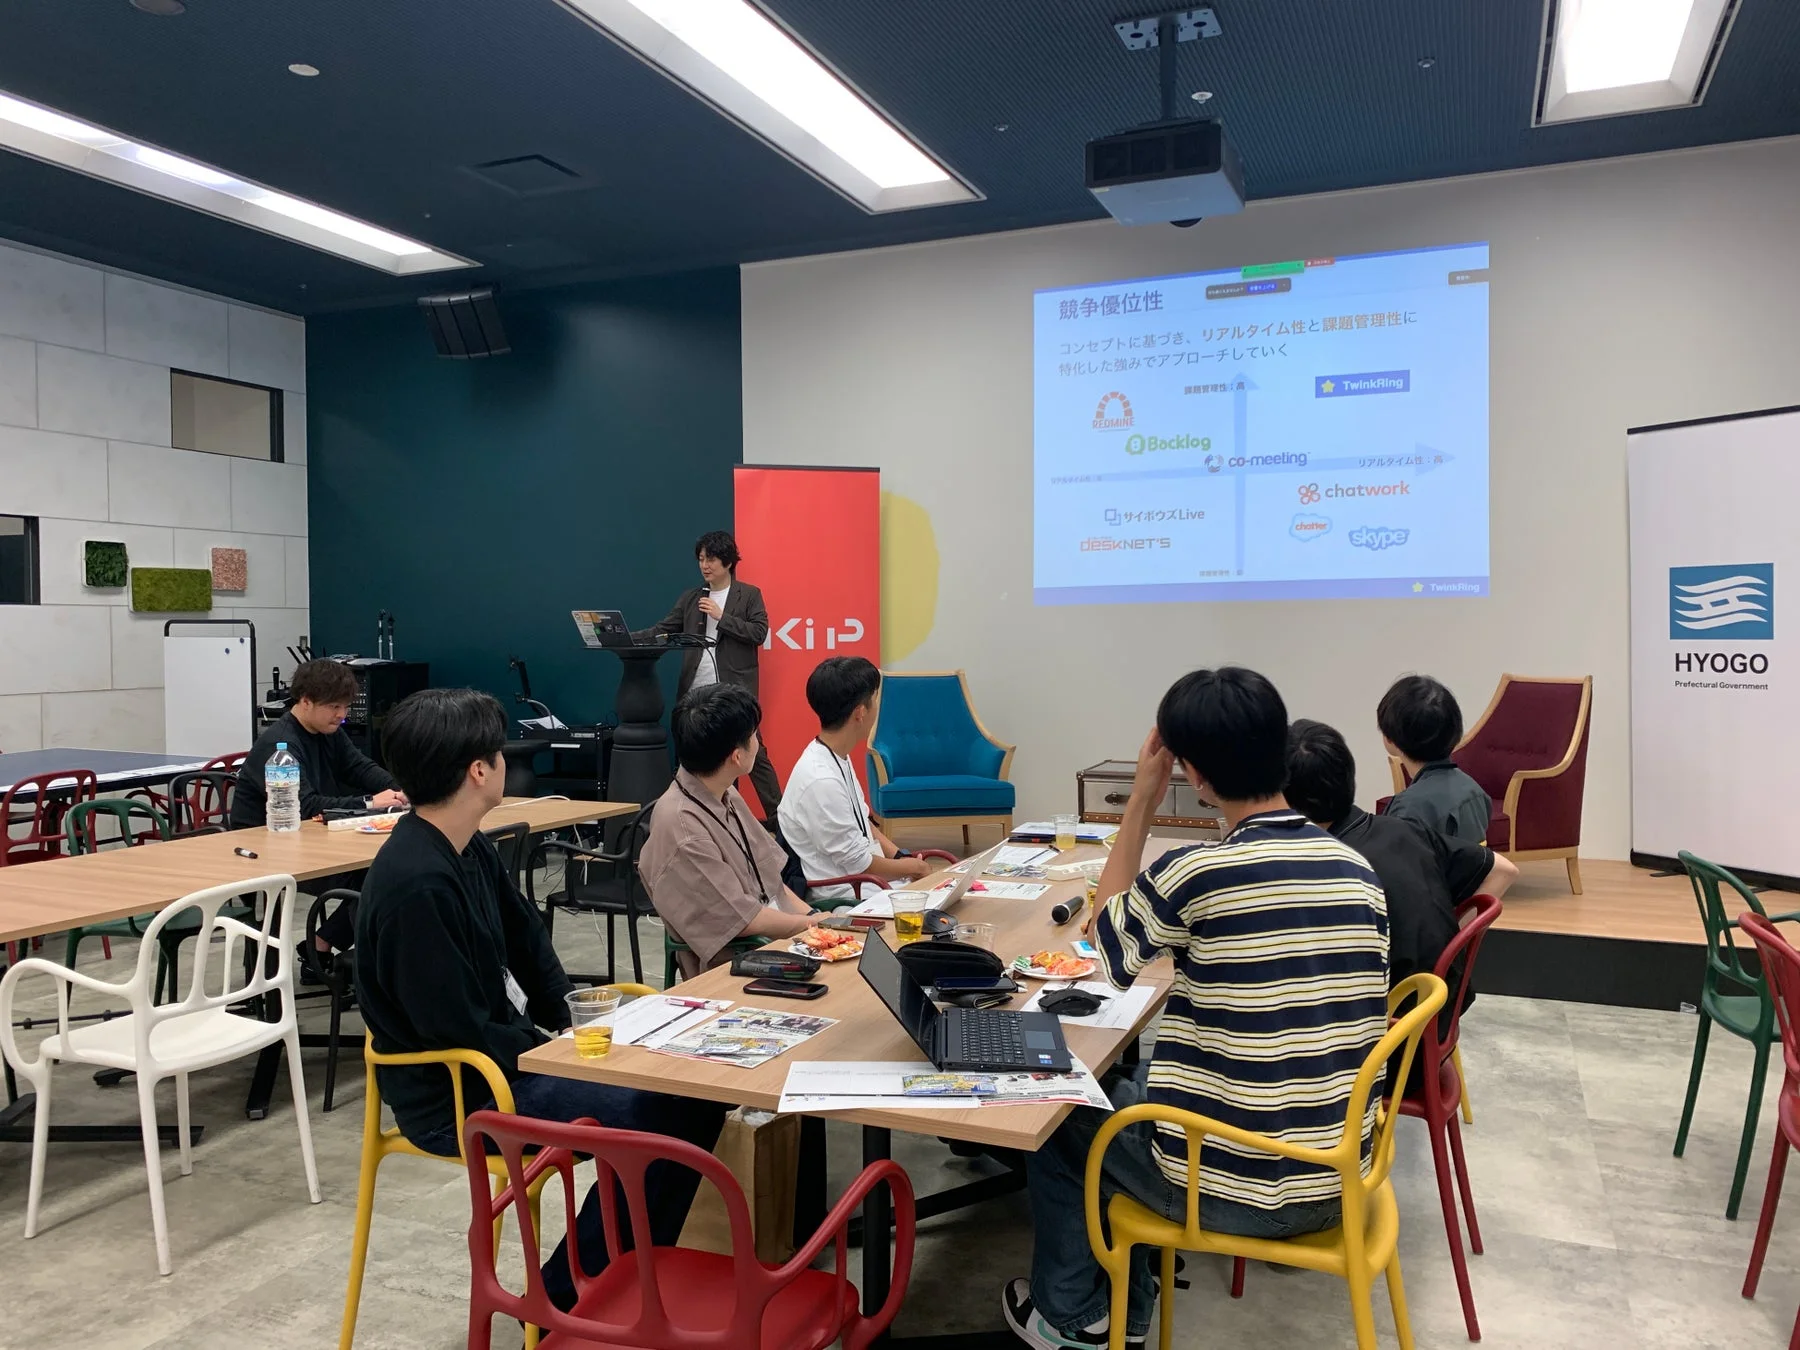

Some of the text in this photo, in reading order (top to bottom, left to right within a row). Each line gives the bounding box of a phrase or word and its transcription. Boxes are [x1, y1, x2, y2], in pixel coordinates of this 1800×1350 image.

[1058, 289, 1164, 321] 競争優位性
[1058, 341, 1288, 377] 特化した強みでアプローチしていく
[1342, 376, 1404, 392] TwinkRing
[1092, 417, 1135, 430] REDMINE
[1147, 434, 1212, 452] Backlog
[1227, 451, 1308, 468] co-meeting
[1325, 481, 1411, 499] chatwork
[1123, 507, 1205, 523] サイボウズLive
[1295, 522, 1328, 531] chatter
[1352, 526, 1406, 550] skype
[1429, 581, 1480, 594] TwinkRing
[1674, 652, 1769, 674] HYOGO
[1674, 680, 1769, 690] Prefectural Government
